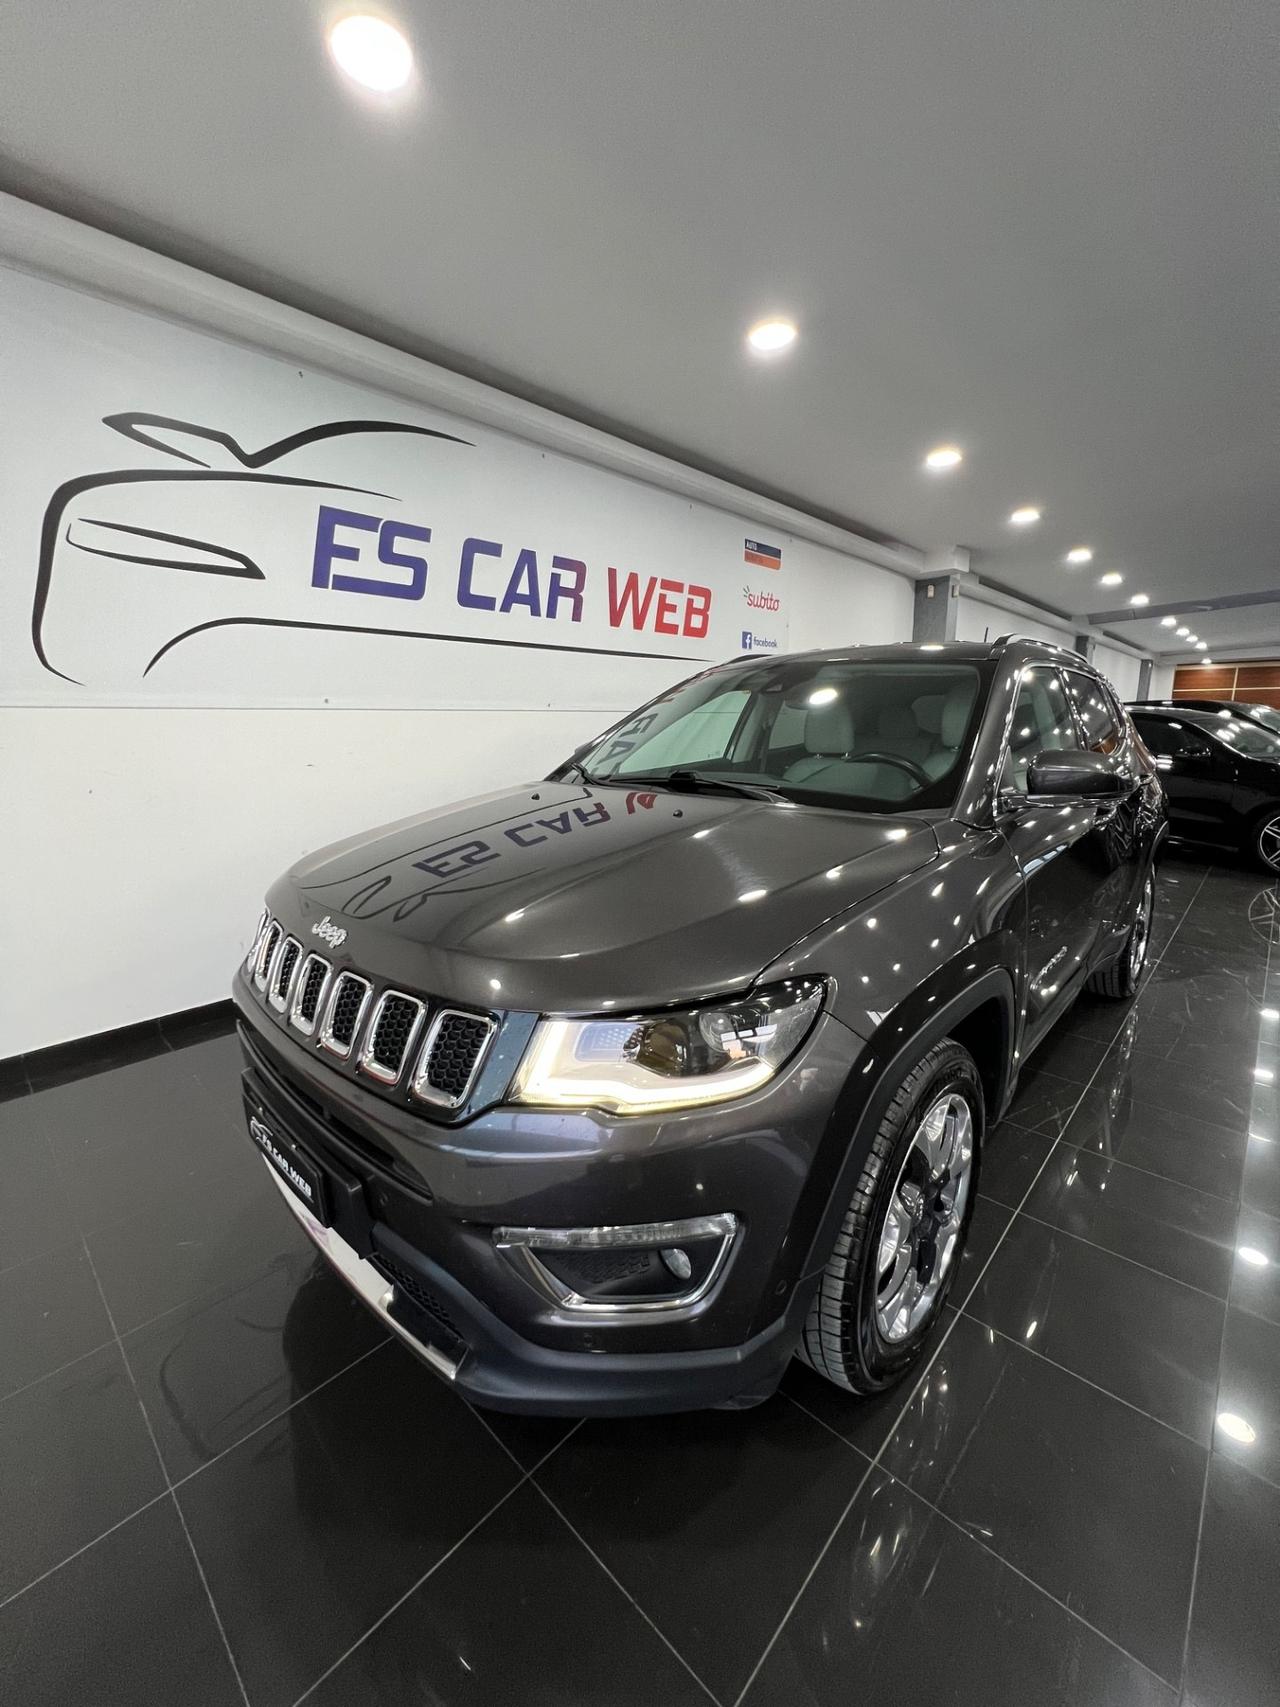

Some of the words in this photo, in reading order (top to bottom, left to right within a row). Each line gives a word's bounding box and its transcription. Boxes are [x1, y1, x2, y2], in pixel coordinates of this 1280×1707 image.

[311, 505, 432, 601] ES
[457, 537, 587, 622] CAR
[607, 567, 713, 639] WEB
[747, 591, 780, 612] subito
[753, 636, 778, 648] facebook
[311, 916, 348, 949] Jeep
